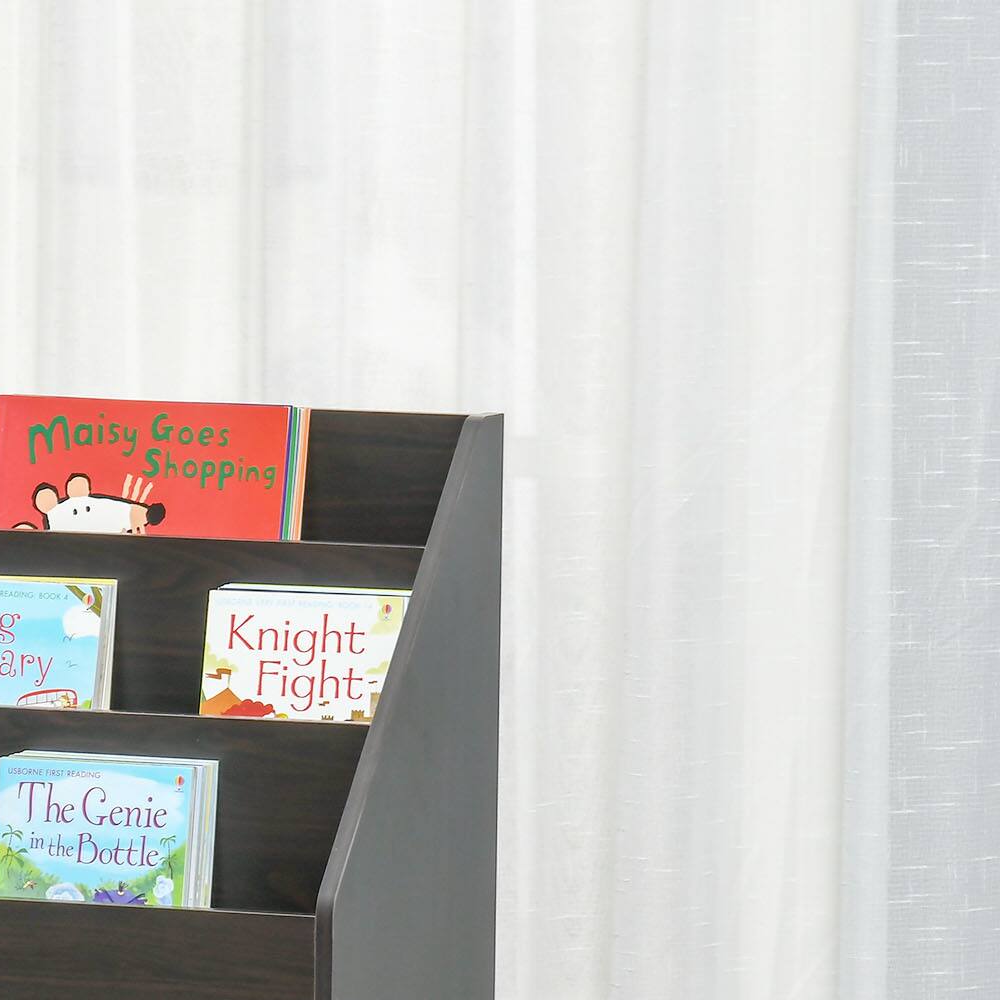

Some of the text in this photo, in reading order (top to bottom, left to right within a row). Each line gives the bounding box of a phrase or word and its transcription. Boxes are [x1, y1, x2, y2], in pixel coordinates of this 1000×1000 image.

[28, 413, 230, 464] Maisy Goes
[142, 448, 276, 489] Shopping
[39, 591, 60, 600] BOOK
[228, 613, 365, 666] Knight
[256, 659, 363, 711] Fight
[8, 767, 101, 779] USBORNE FIRST READING
[17, 781, 167, 828] The Genie
[30, 831, 160, 867] in the Bottle
